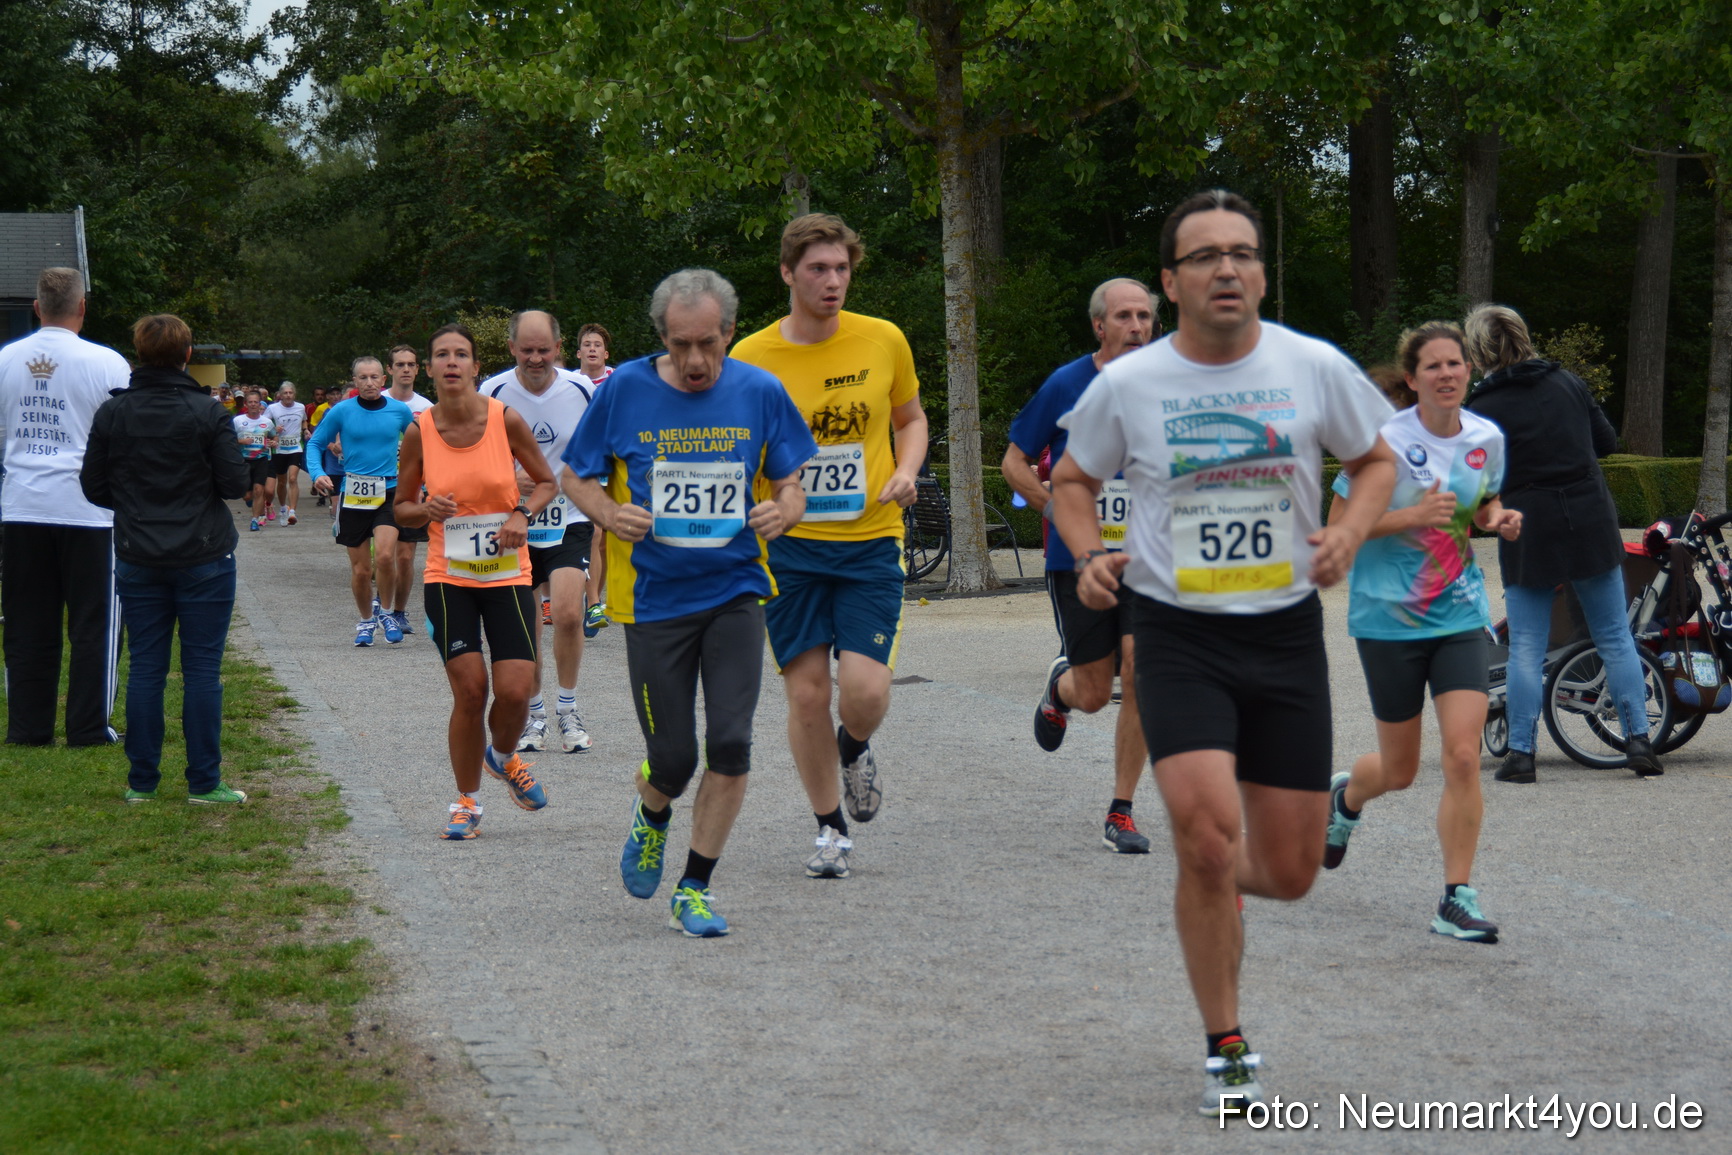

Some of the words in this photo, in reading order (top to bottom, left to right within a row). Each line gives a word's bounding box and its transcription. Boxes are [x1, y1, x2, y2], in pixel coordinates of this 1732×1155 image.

[35, 380, 48, 391] IM
[824, 374, 856, 388] swn
[1160, 387, 1290, 414] BLACKMORES
[22, 412, 60, 426] SEINER
[638, 431, 657, 443] 10.
[659, 427, 751, 441] NEUMARKTER
[26, 443, 58, 456] JESUS
[656, 440, 736, 454] STADTLAUF
[655, 470, 687, 478] PARTL
[689, 471, 732, 479] Neumarkt
[1194, 464, 1296, 483] FINISHER
[352, 481, 376, 496] 281
[663, 483, 736, 514] 2512
[1173, 505, 1214, 516] PARTL
[1217, 503, 1274, 515] Neumarkt
[445, 523, 471, 531] PARTL
[472, 521, 506, 529] Neumark
[688, 523, 712, 535] Otto
[469, 531, 499, 556] 13
[1200, 519, 1272, 562] 526
[469, 562, 499, 573] Milena
